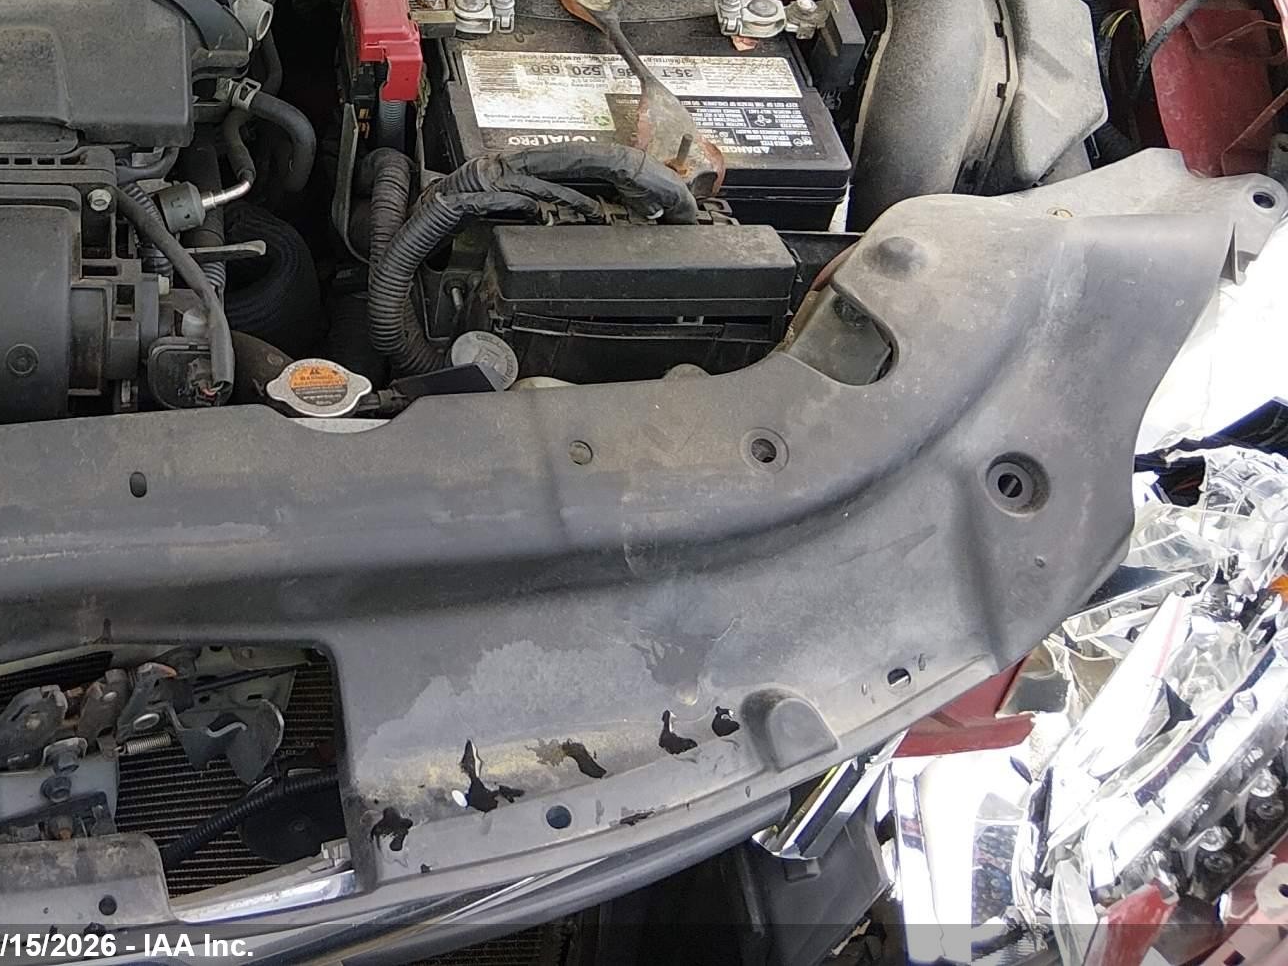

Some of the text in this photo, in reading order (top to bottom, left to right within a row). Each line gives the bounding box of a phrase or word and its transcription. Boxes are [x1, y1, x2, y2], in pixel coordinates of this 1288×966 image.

[531, 64, 560, 74] 650
[572, 65, 601, 76] 520
[662, 69, 693, 78] 35-T
